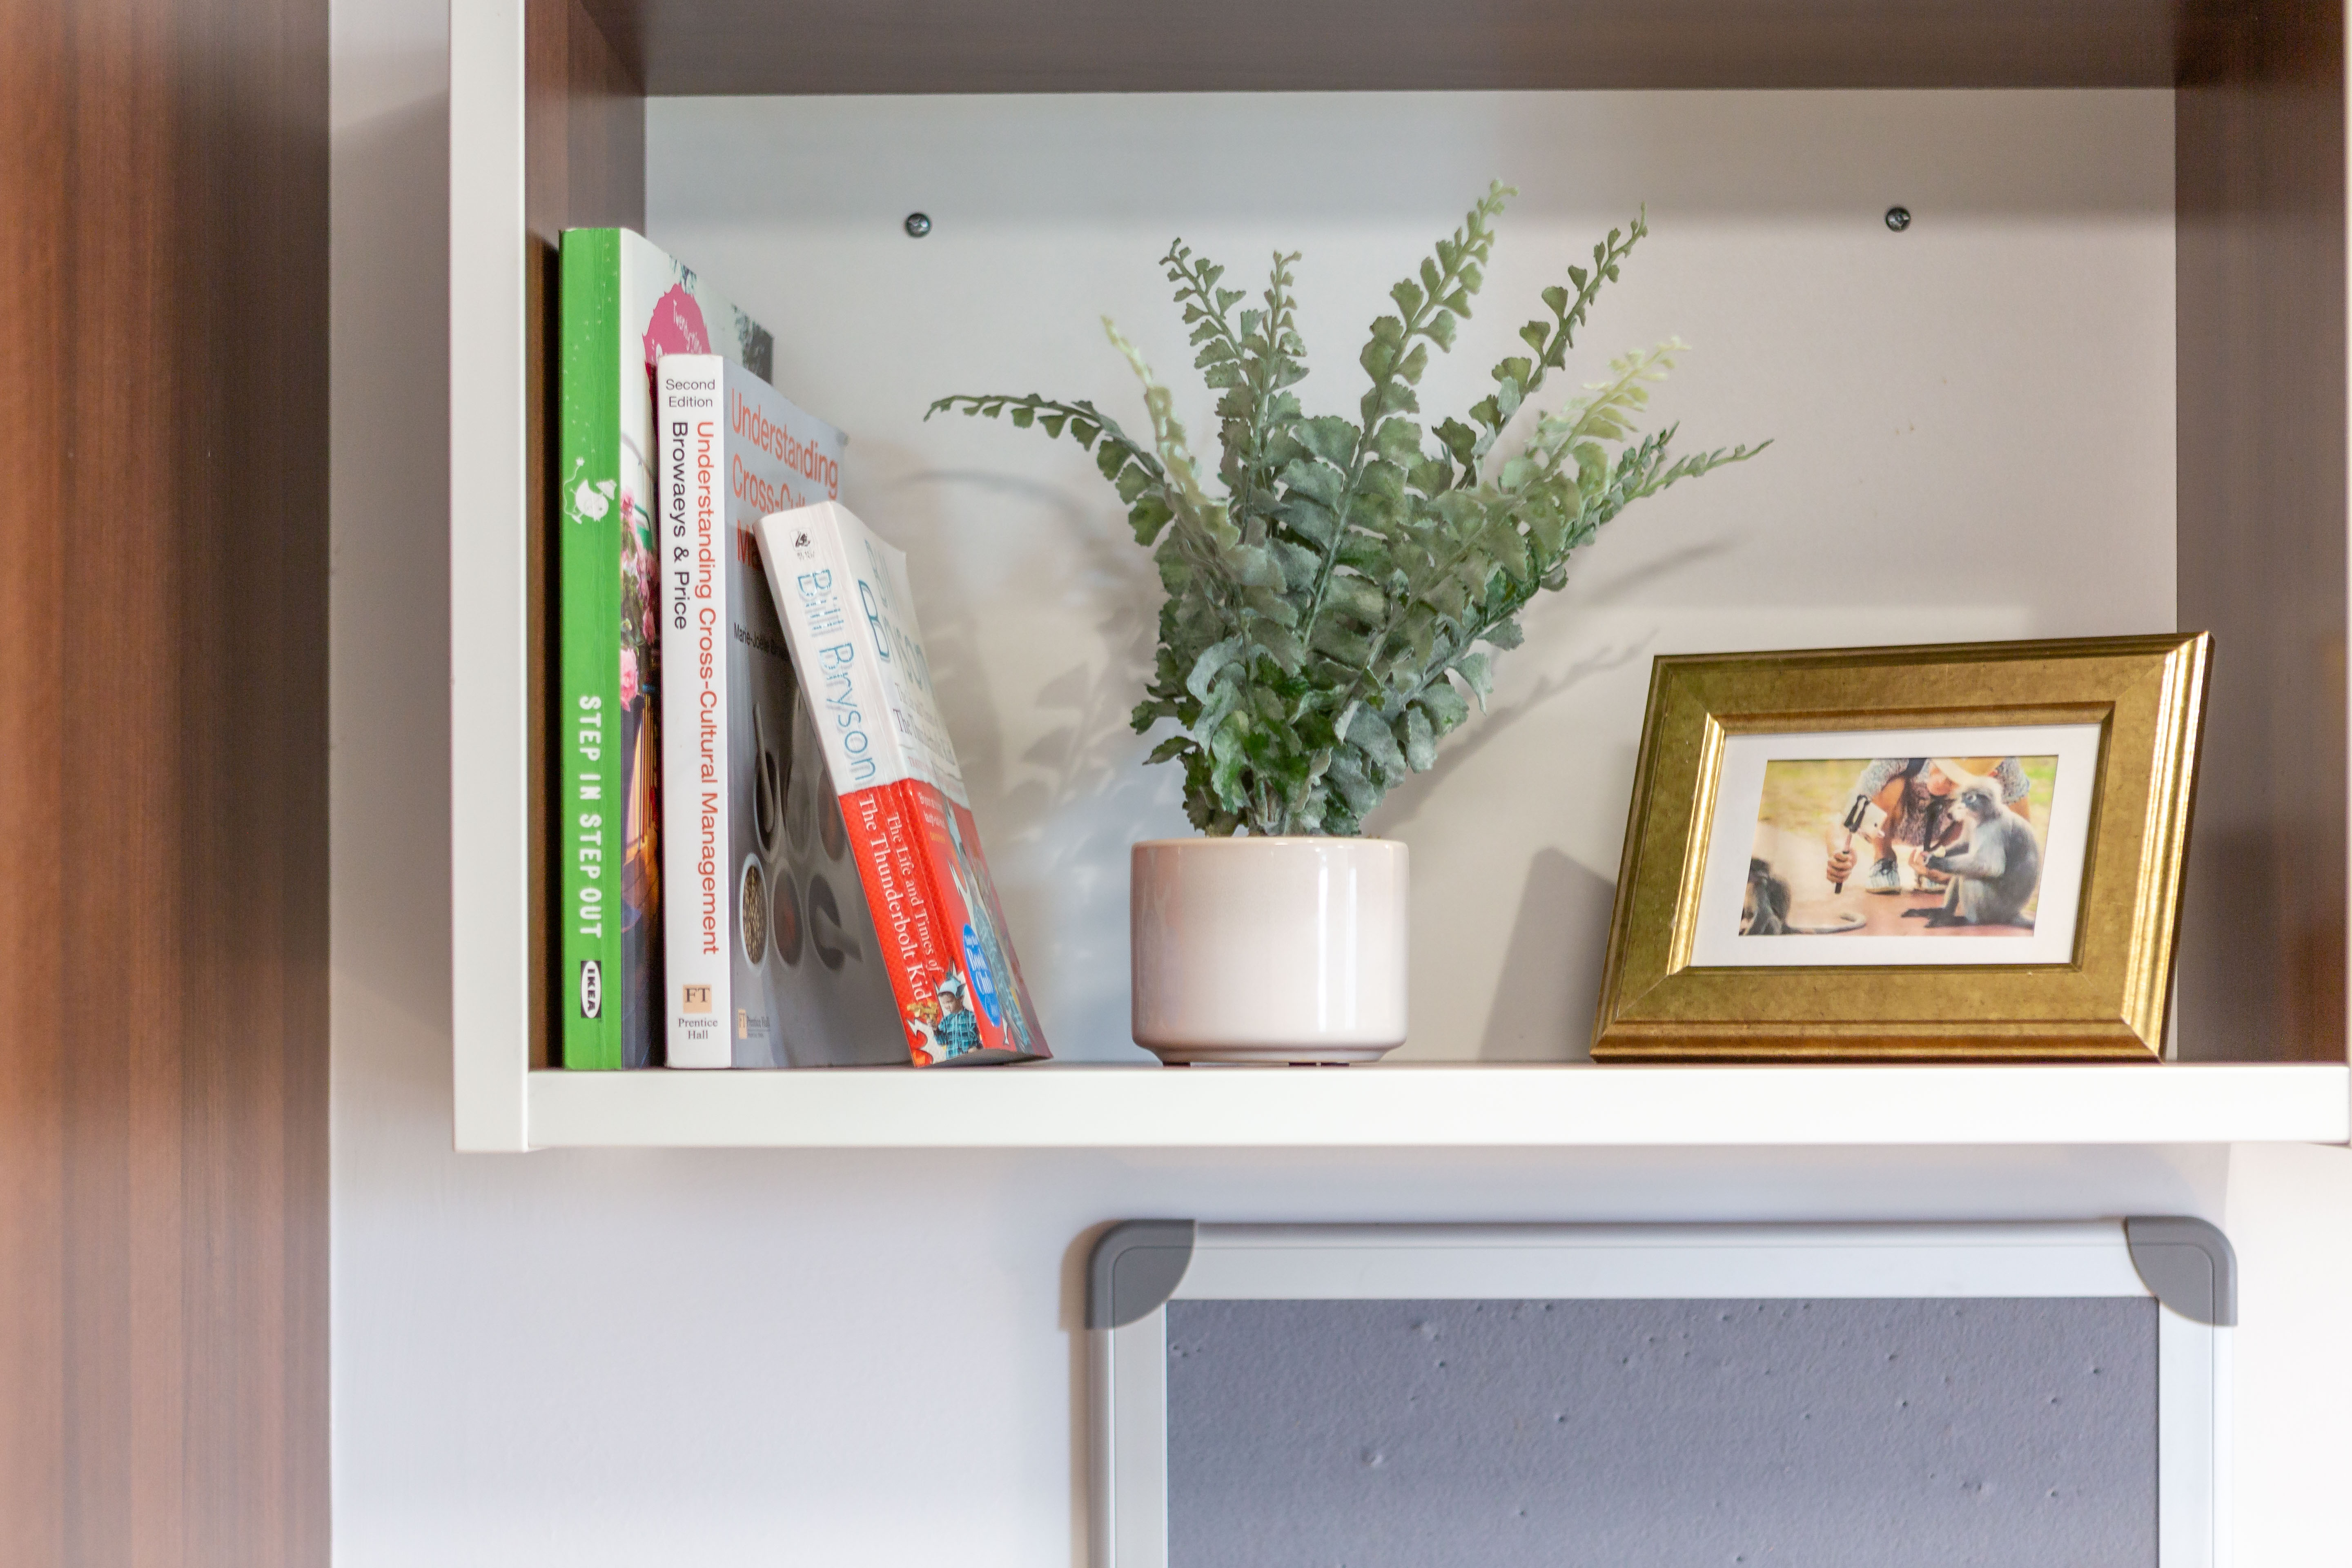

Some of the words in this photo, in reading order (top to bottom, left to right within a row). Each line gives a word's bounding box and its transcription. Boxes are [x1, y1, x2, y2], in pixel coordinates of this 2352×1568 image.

[666, 379, 715, 390] Second
[669, 396, 713, 408] Edition
[732, 388, 839, 501] Understanding
[669, 422, 688, 538] Browaeys
[694, 421, 715, 599] Understanding
[673, 546, 689, 563] &
[674, 571, 690, 630] Price
[797, 569, 844, 631] Bill
[698, 607, 718, 784] Cross-Cultural
[819, 643, 876, 782] Bryson
[579, 695, 601, 762] STEP
[579, 773, 601, 800] IN
[579, 813, 602, 879] STEP
[887, 811, 902, 843] The
[697, 792, 719, 954] Management
[896, 846, 914, 876] Life
[579, 887, 602, 938] OUT
[859, 793, 878, 831] The
[871, 832, 918, 960] Thunderbolt
[906, 961, 932, 1001] Kid
[905, 879, 924, 906] and
[914, 907, 934, 956] Times
[926, 958, 944, 973] of
[587, 968, 596, 1013] IKEA
[686, 988, 710, 1003] FT
[678, 1017, 718, 1028] Prentice
[688, 1029, 708, 1040] Hall
